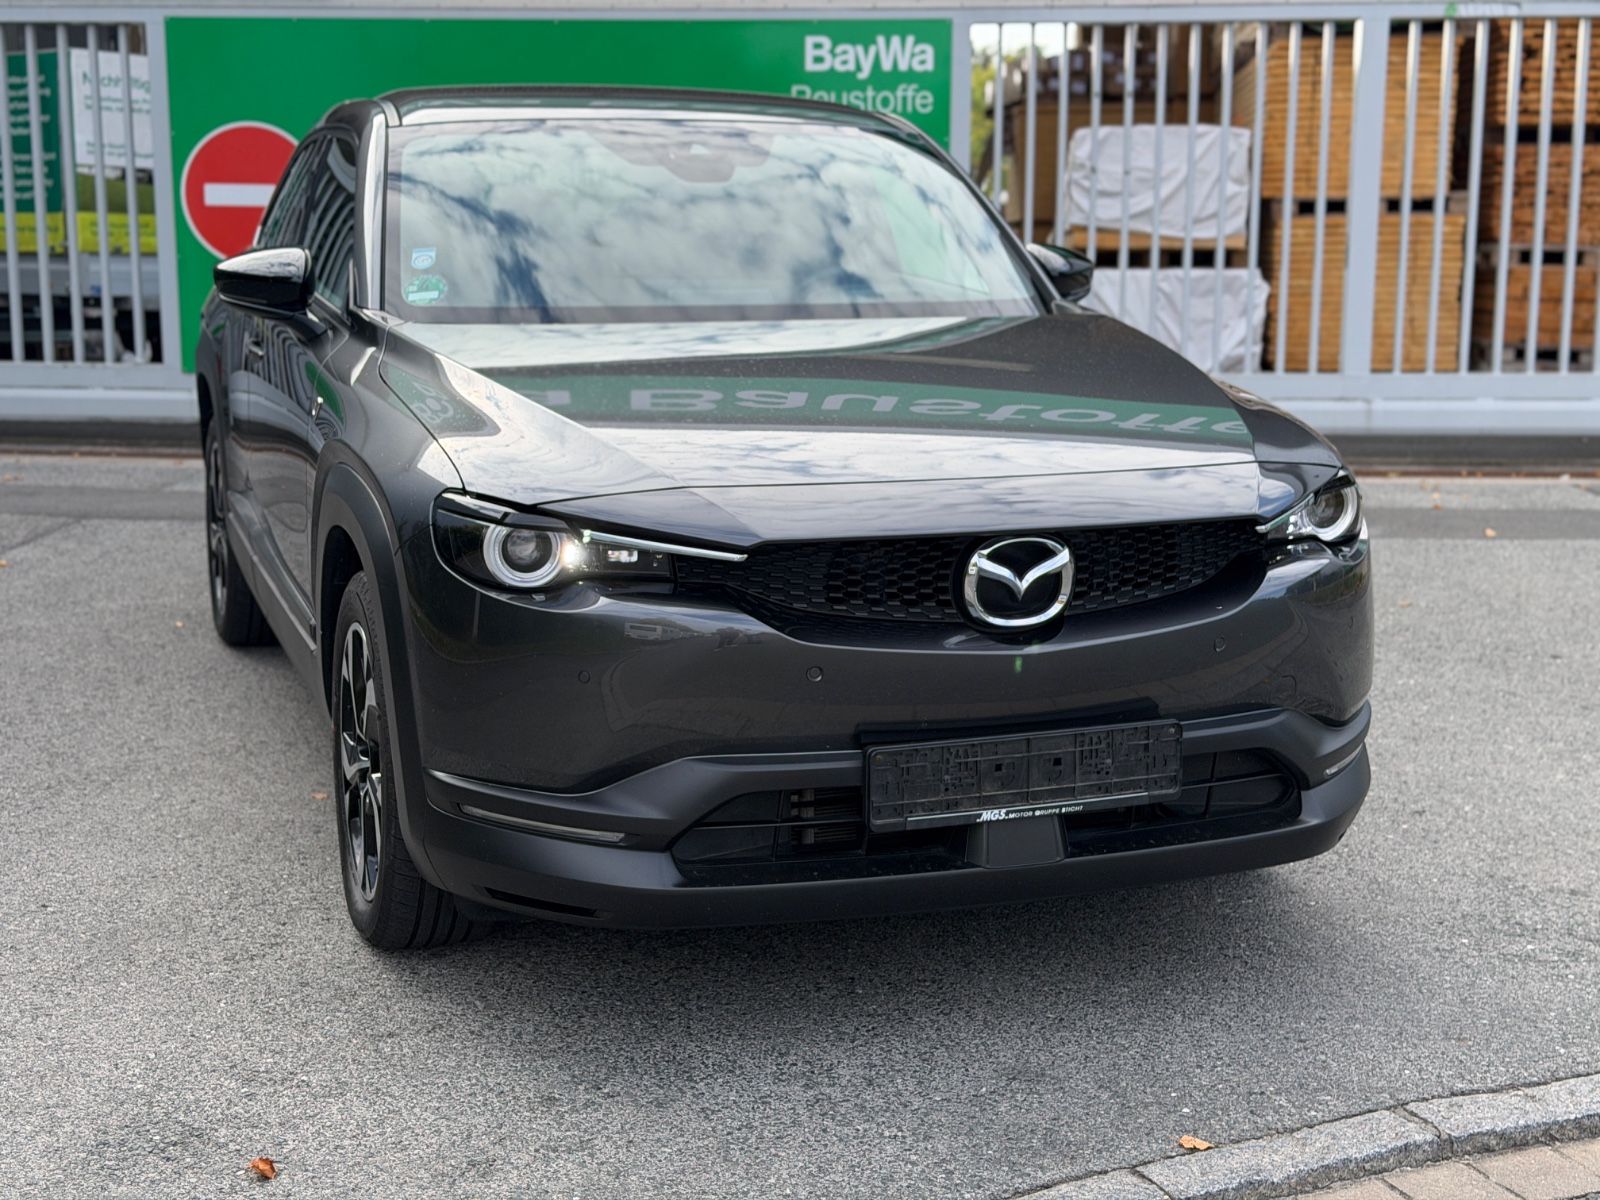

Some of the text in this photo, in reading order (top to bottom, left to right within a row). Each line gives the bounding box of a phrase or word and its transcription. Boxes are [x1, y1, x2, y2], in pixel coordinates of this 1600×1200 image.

[804, 34, 935, 80] BayWa
[1008, 810, 1033, 820] MOTOR
[1034, 807, 1060, 817] GRUPPE
